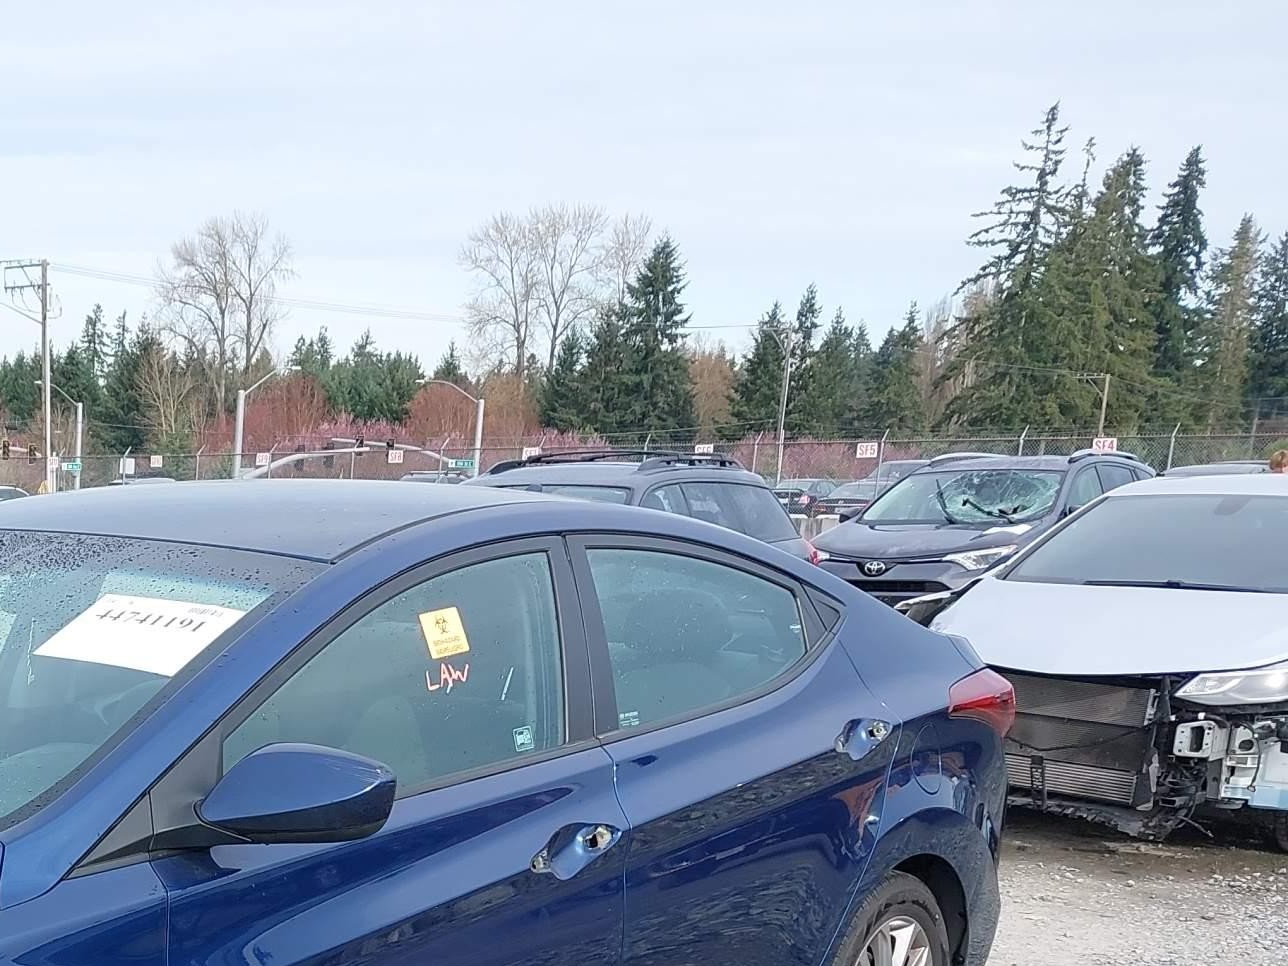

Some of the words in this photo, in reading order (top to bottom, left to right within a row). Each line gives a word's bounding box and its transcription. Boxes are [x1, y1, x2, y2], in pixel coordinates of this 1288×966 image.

[858, 444, 876, 457] SF5
[1094, 439, 1115, 450] SF4
[95, 608, 206, 632] 44741191
[425, 662, 470, 692] LAW
